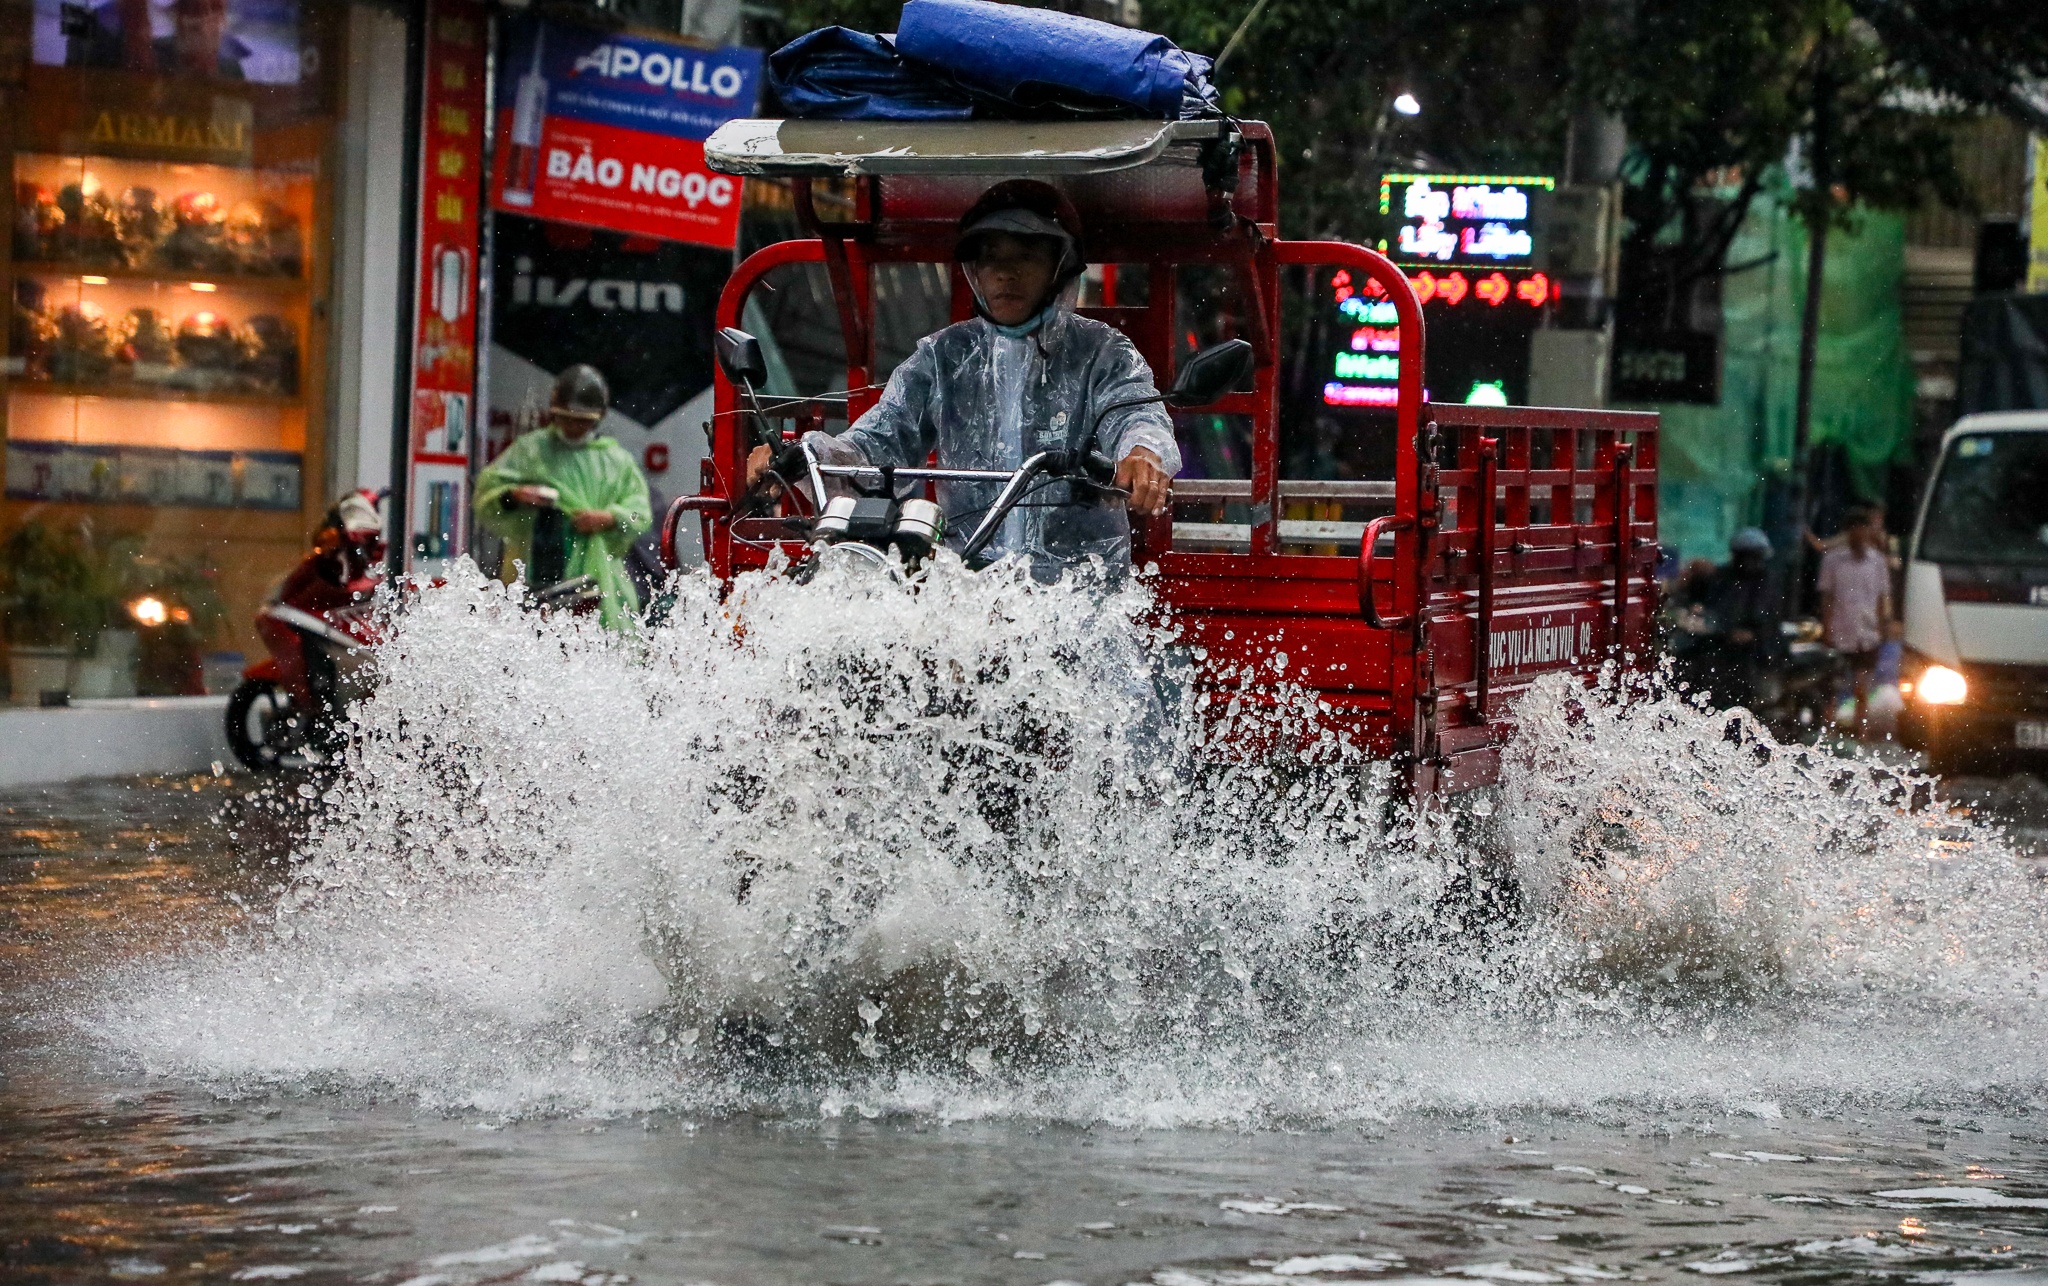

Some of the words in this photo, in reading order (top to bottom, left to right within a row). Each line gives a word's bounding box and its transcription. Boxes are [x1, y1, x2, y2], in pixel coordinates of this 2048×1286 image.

[573, 43, 743, 98] APOLLO
[88, 111, 244, 151] ARMANI
[546, 142, 624, 188] BẢO
[630, 162, 734, 209] NGỌC
[1522, 618, 1534, 664] LÀ
[1535, 613, 1558, 663] NIỀM
